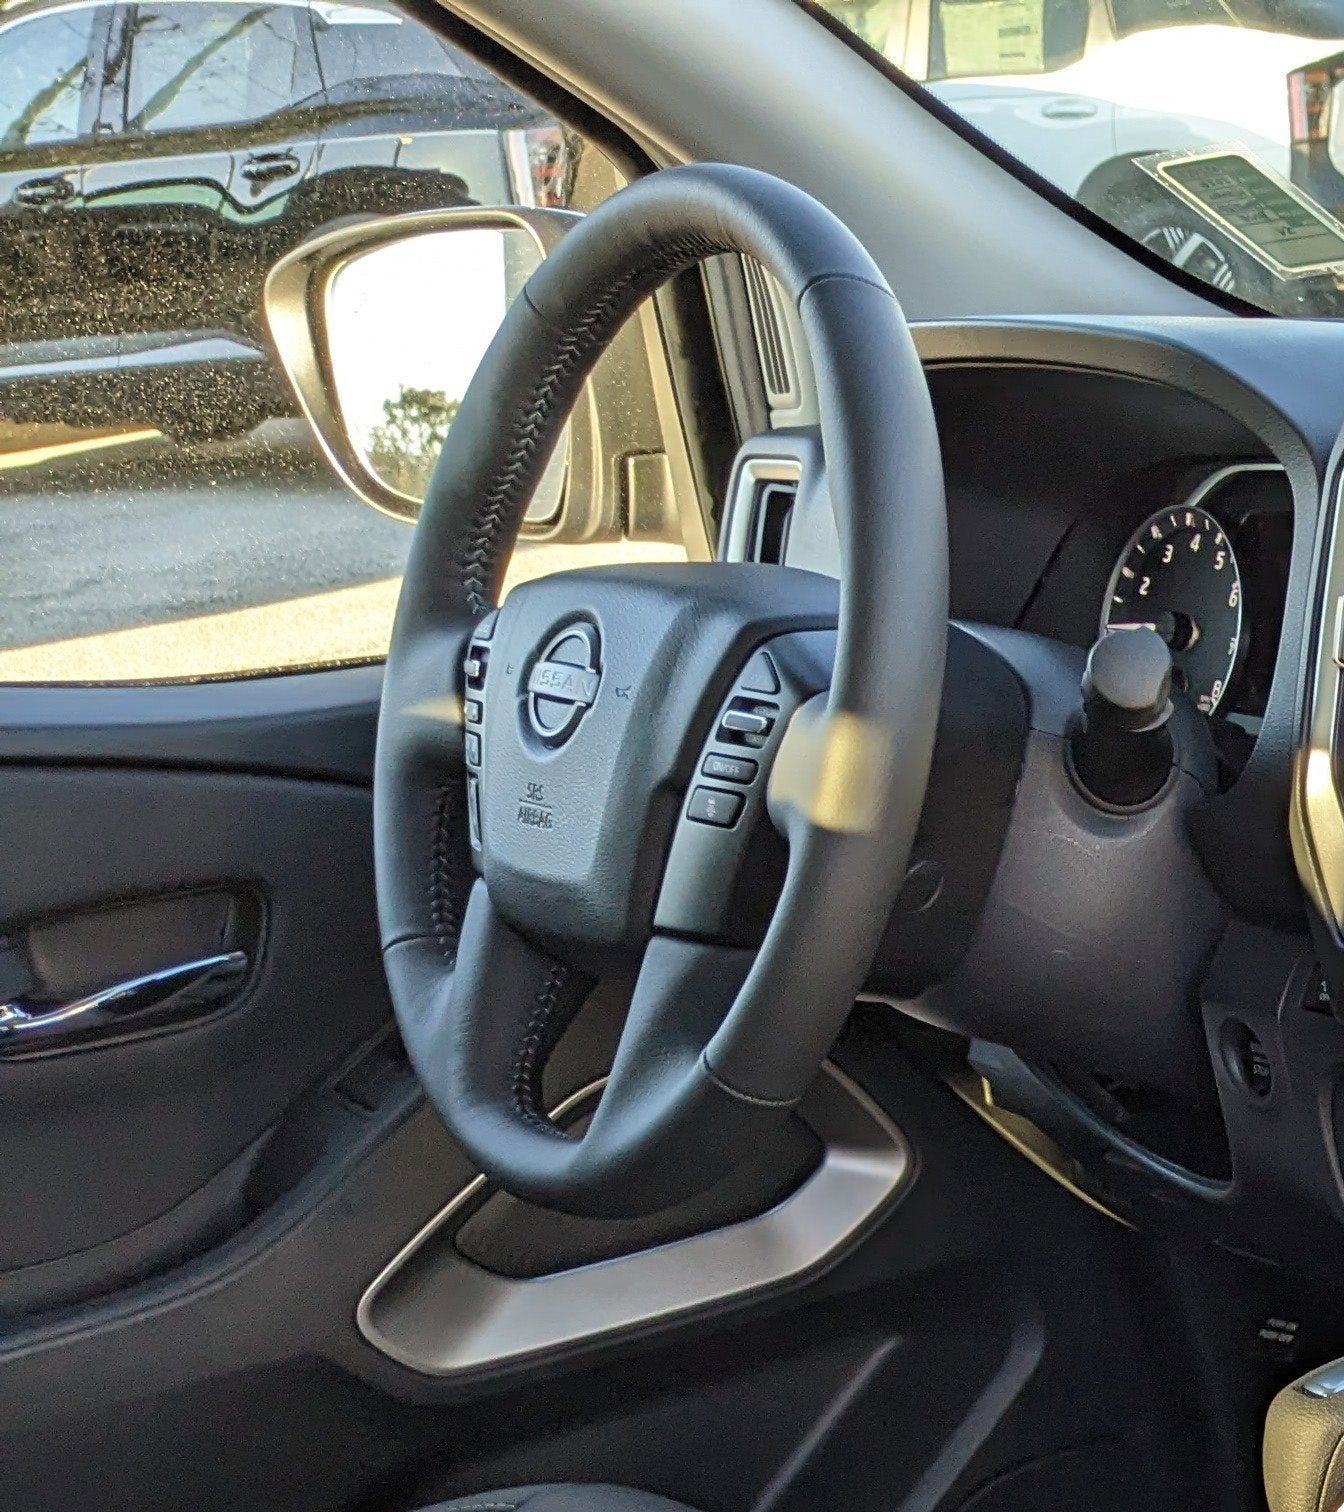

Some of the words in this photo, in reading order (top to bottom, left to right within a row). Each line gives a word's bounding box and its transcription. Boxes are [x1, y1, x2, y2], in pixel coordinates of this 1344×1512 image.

[1189, 534, 1201, 552] 4
[1162, 544, 1174, 563] 3
[1214, 550, 1226, 570] 5
[1139, 576, 1151, 596] 2
[1228, 589, 1240, 608] 6
